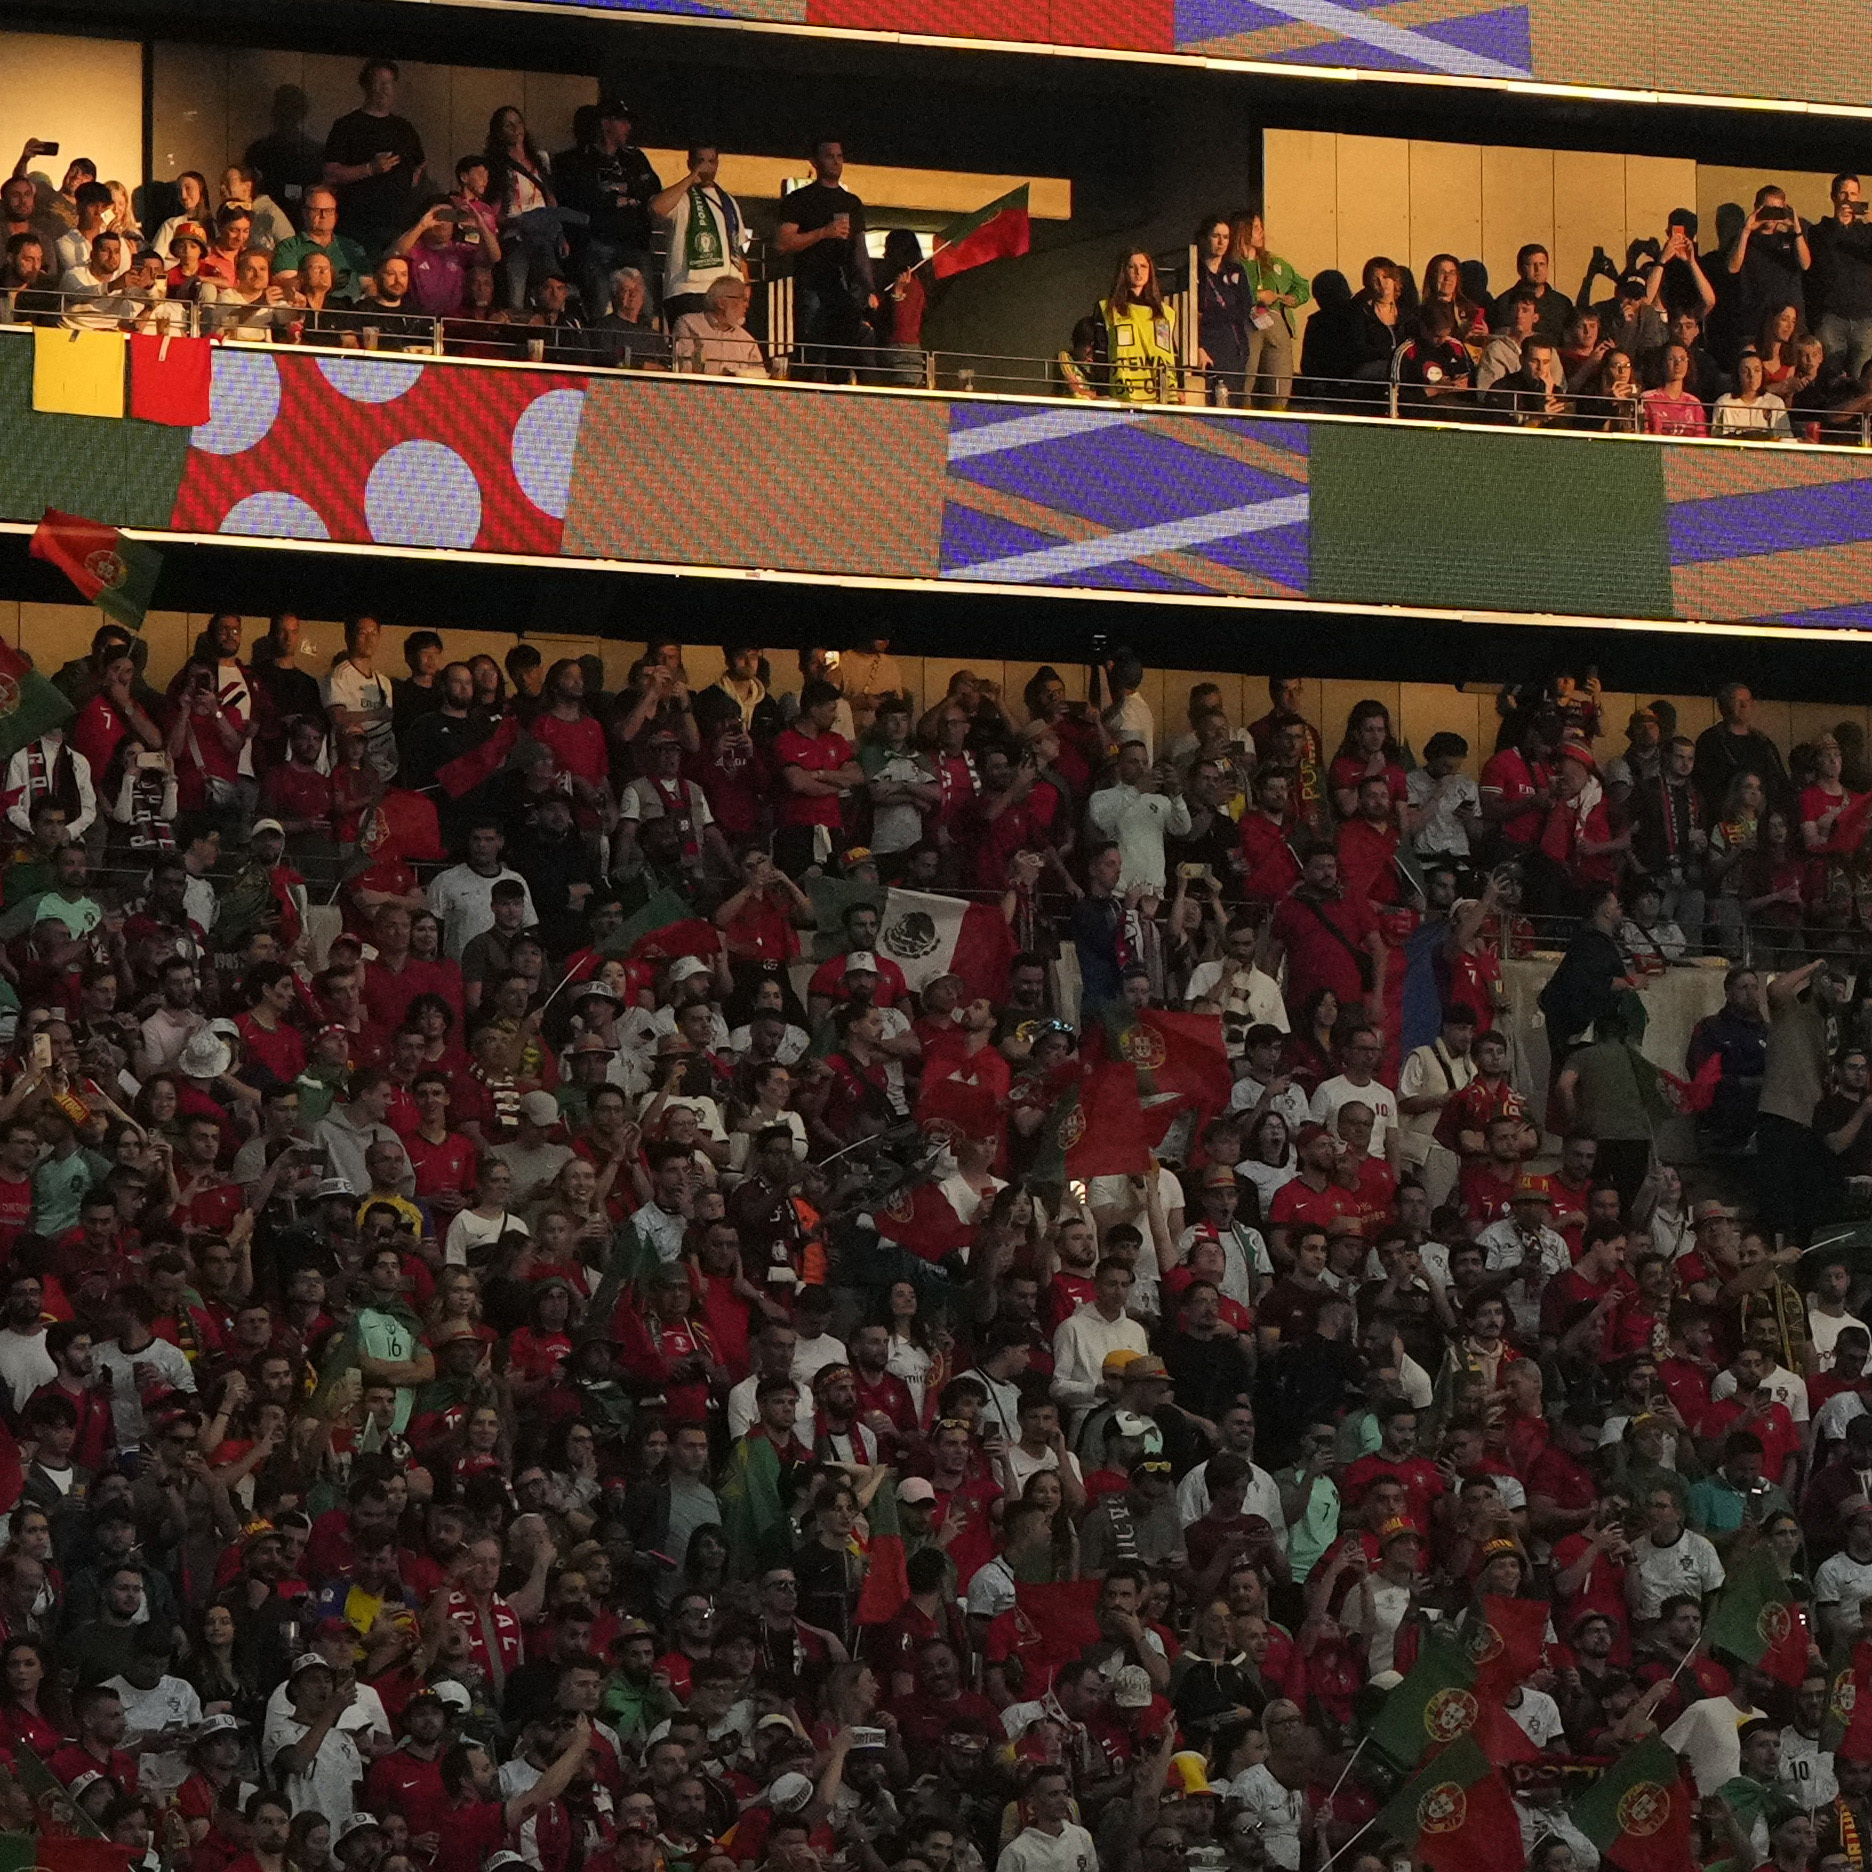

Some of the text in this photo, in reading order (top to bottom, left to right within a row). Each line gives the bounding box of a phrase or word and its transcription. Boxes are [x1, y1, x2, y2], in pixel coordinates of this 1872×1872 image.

[102, 712, 111, 730] 7
[1468, 969, 1477, 986] 7
[1375, 1103, 1389, 1117] 10
[1483, 1202, 1494, 1218] 7
[386, 1336, 402, 1358] 16
[1321, 1502, 1332, 1522] 7
[1790, 1761, 1810, 1782] 10
